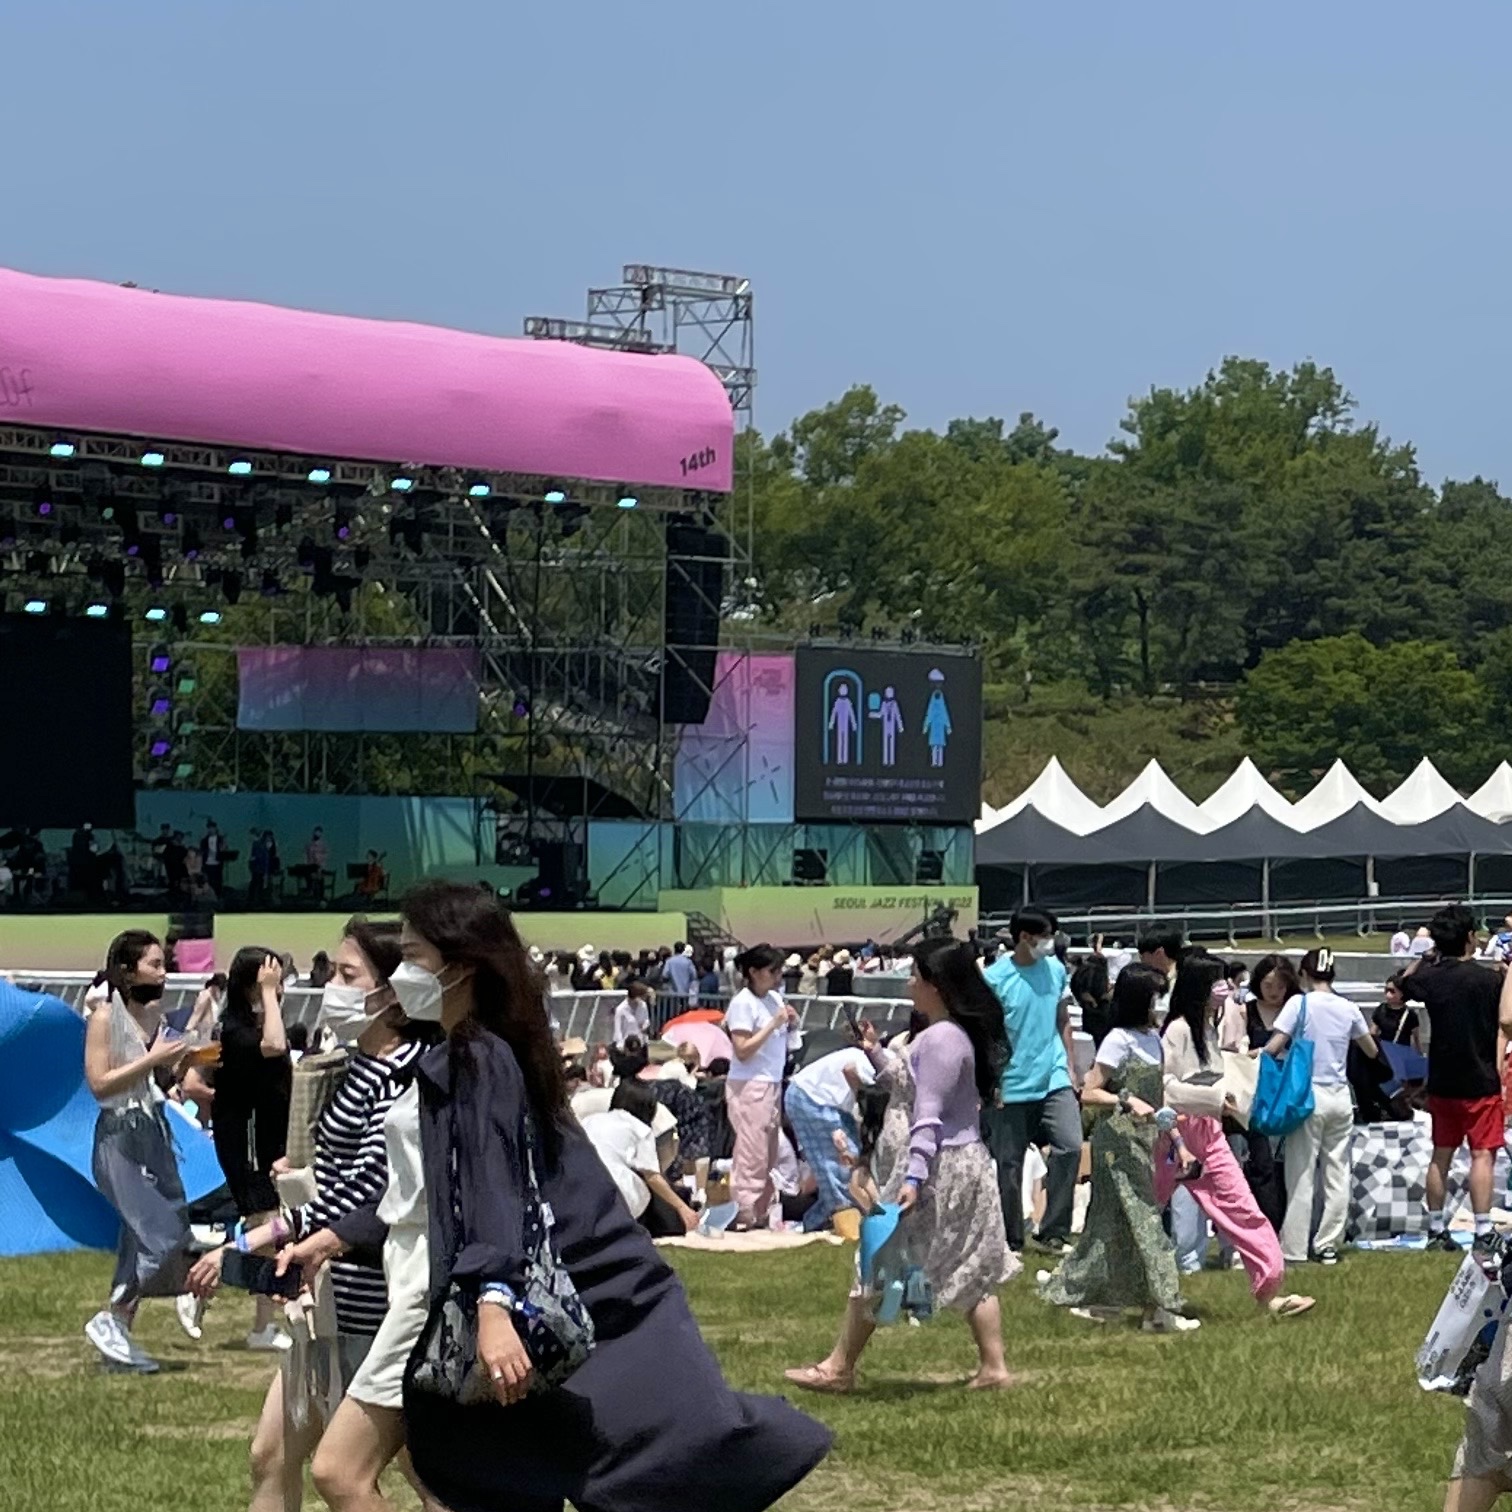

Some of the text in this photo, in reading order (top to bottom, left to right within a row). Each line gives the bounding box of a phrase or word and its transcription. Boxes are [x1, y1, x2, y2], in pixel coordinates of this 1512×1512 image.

[680, 446, 715, 477] 14th
[833, 897, 866, 909] SEOUL
[870, 897, 897, 909] JAZZ
